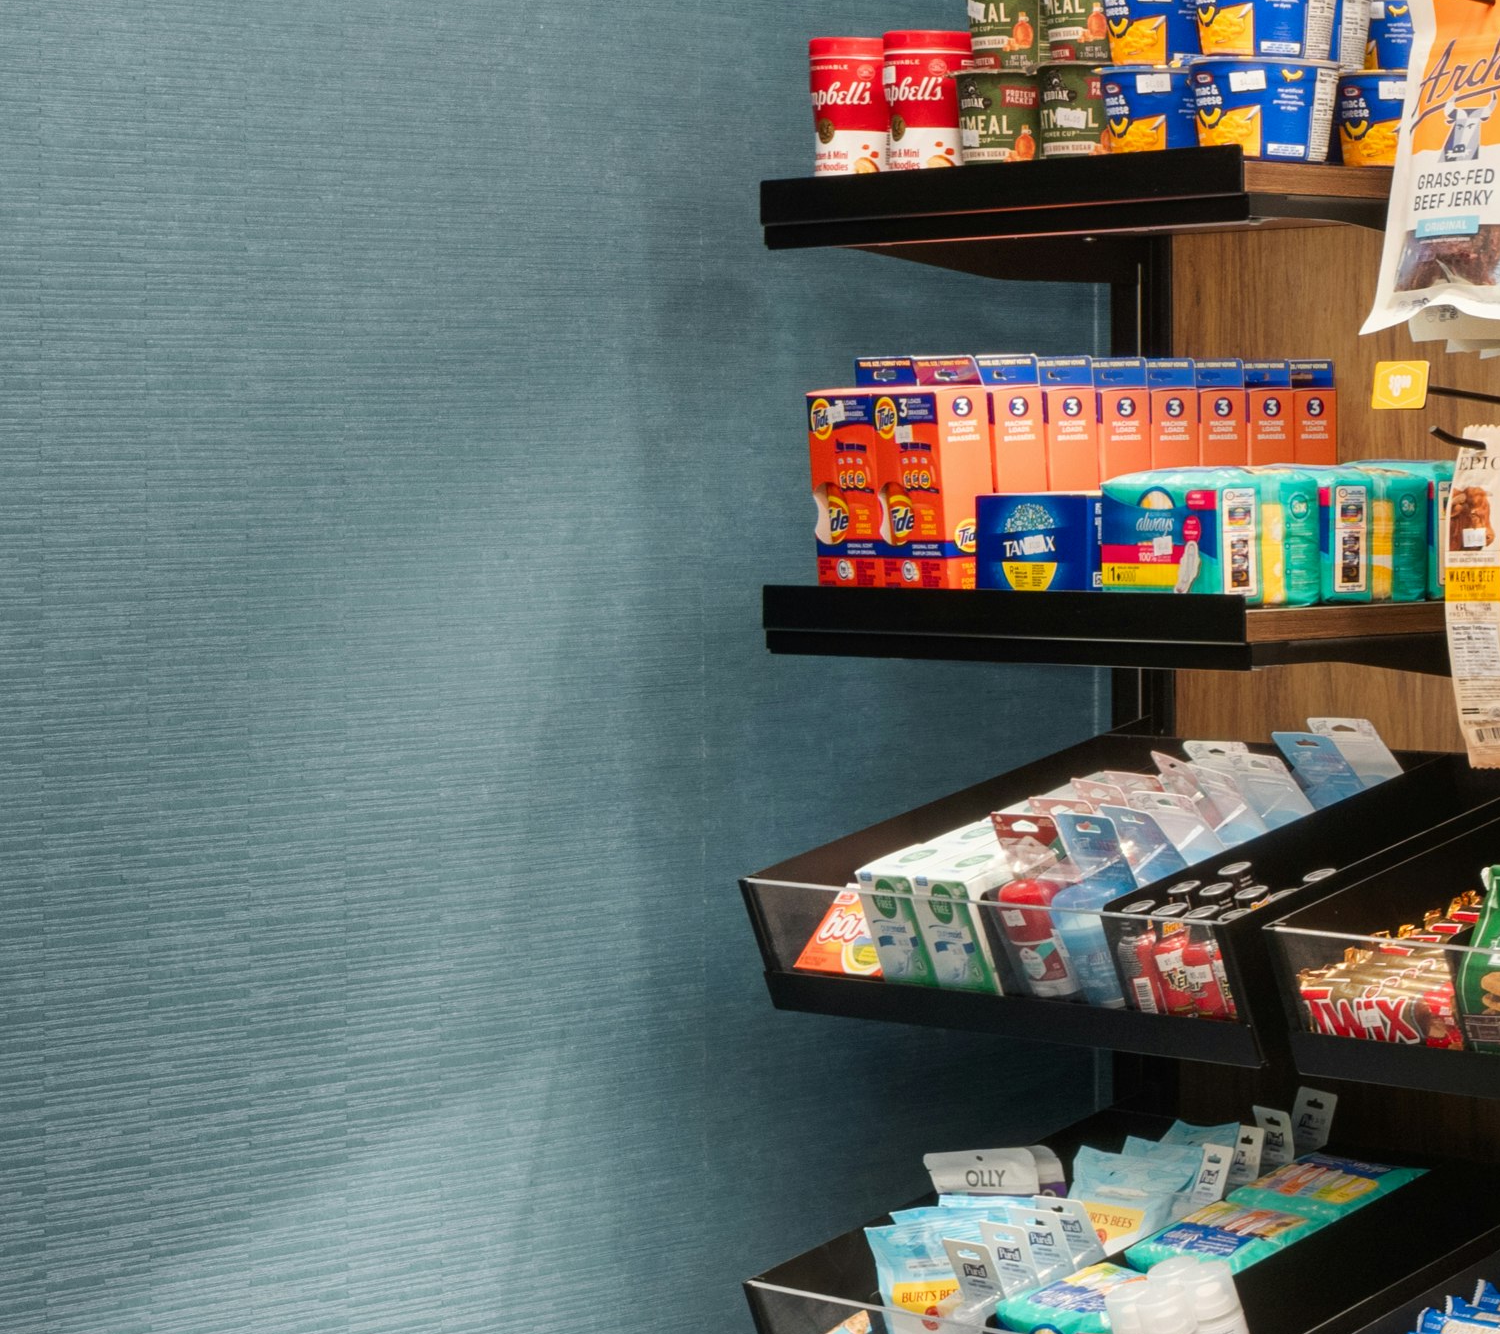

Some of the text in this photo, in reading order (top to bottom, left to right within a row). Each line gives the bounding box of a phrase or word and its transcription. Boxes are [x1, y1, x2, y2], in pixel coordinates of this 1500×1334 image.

[1417, 168, 1495, 190] GRASS-FED
[1414, 188, 1493, 213] BEEF JERKY
[1423, 220, 1468, 235] ORIGINAL
[877, 408, 895, 429] Tide
[1136, 514, 1174, 534] always
[965, 1169, 1006, 1187] OLLY
[902, 1289, 937, 1303] BURT'S
